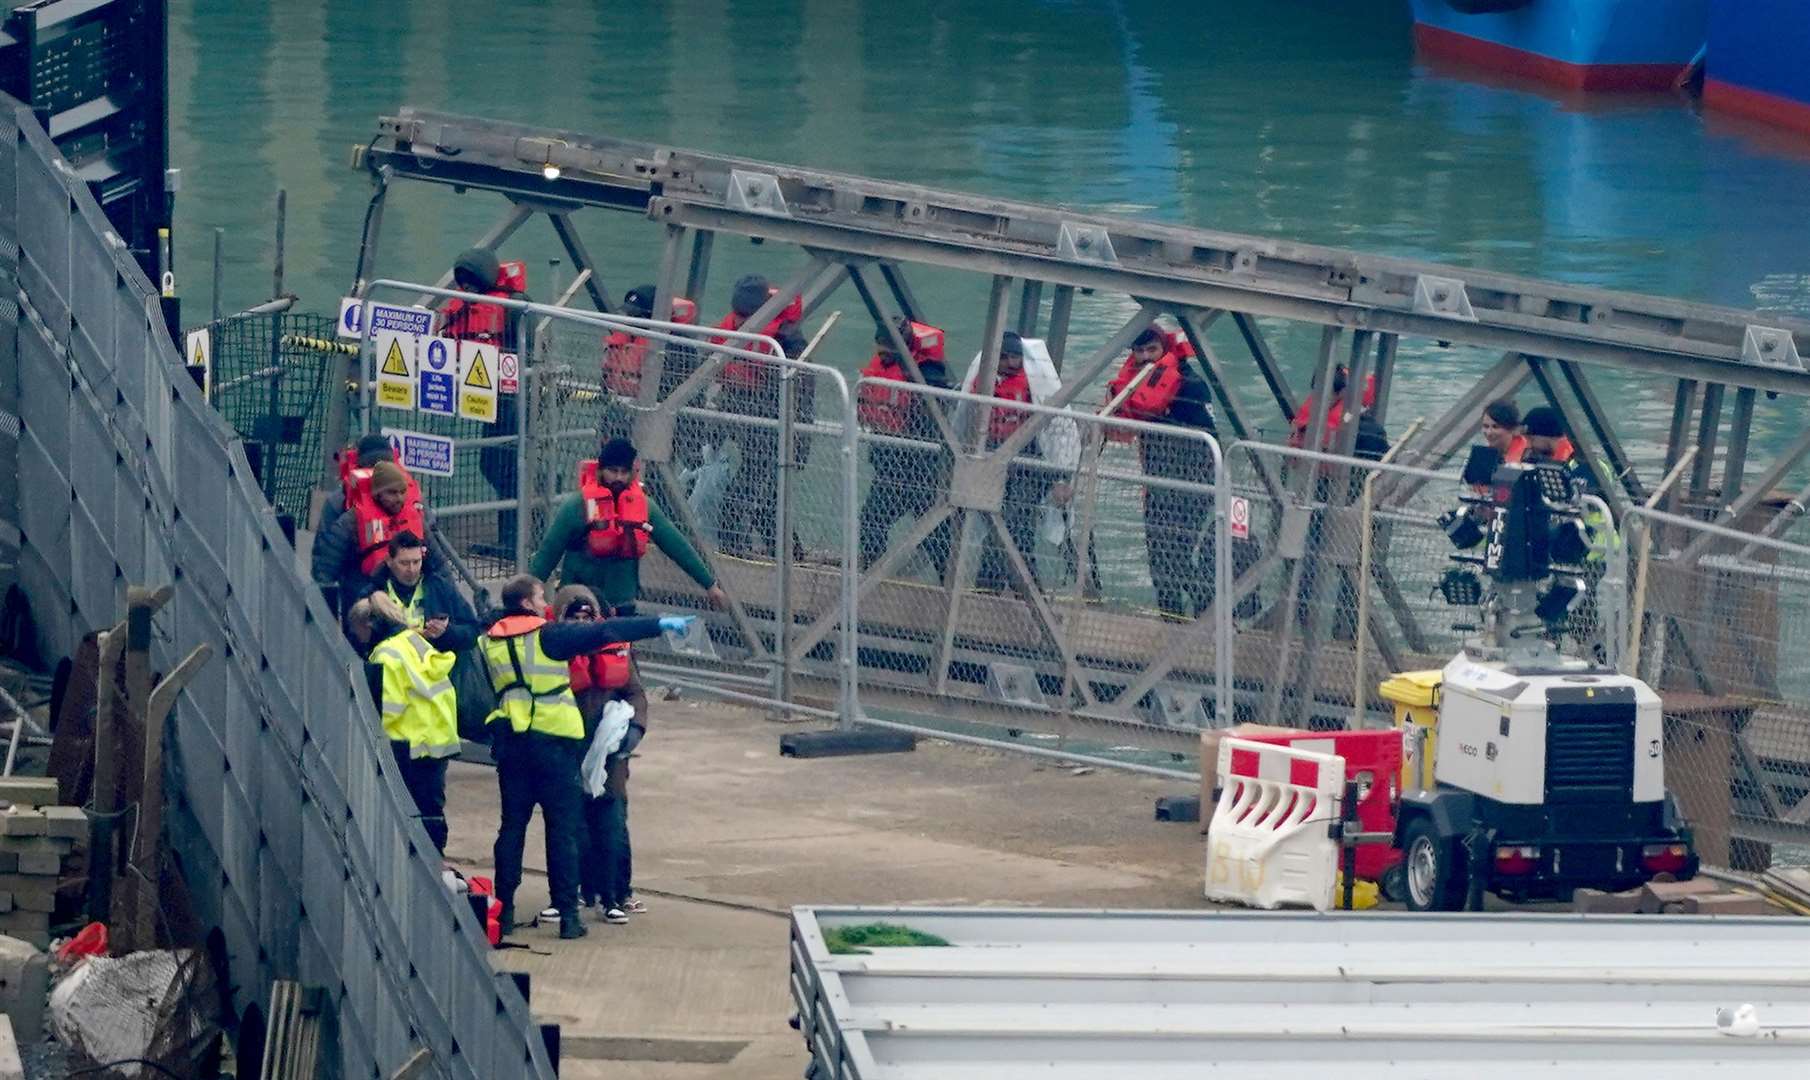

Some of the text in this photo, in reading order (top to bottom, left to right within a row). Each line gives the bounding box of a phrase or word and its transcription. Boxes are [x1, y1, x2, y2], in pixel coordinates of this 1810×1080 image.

[375, 309, 428, 324] MAXIMUM OF
[375, 318, 425, 332] 30 PERSONS
[406, 437, 448, 452] MAXIMUM OF
[417, 448, 448, 462] PERSONS
[1488, 506, 1506, 569] TRIME
